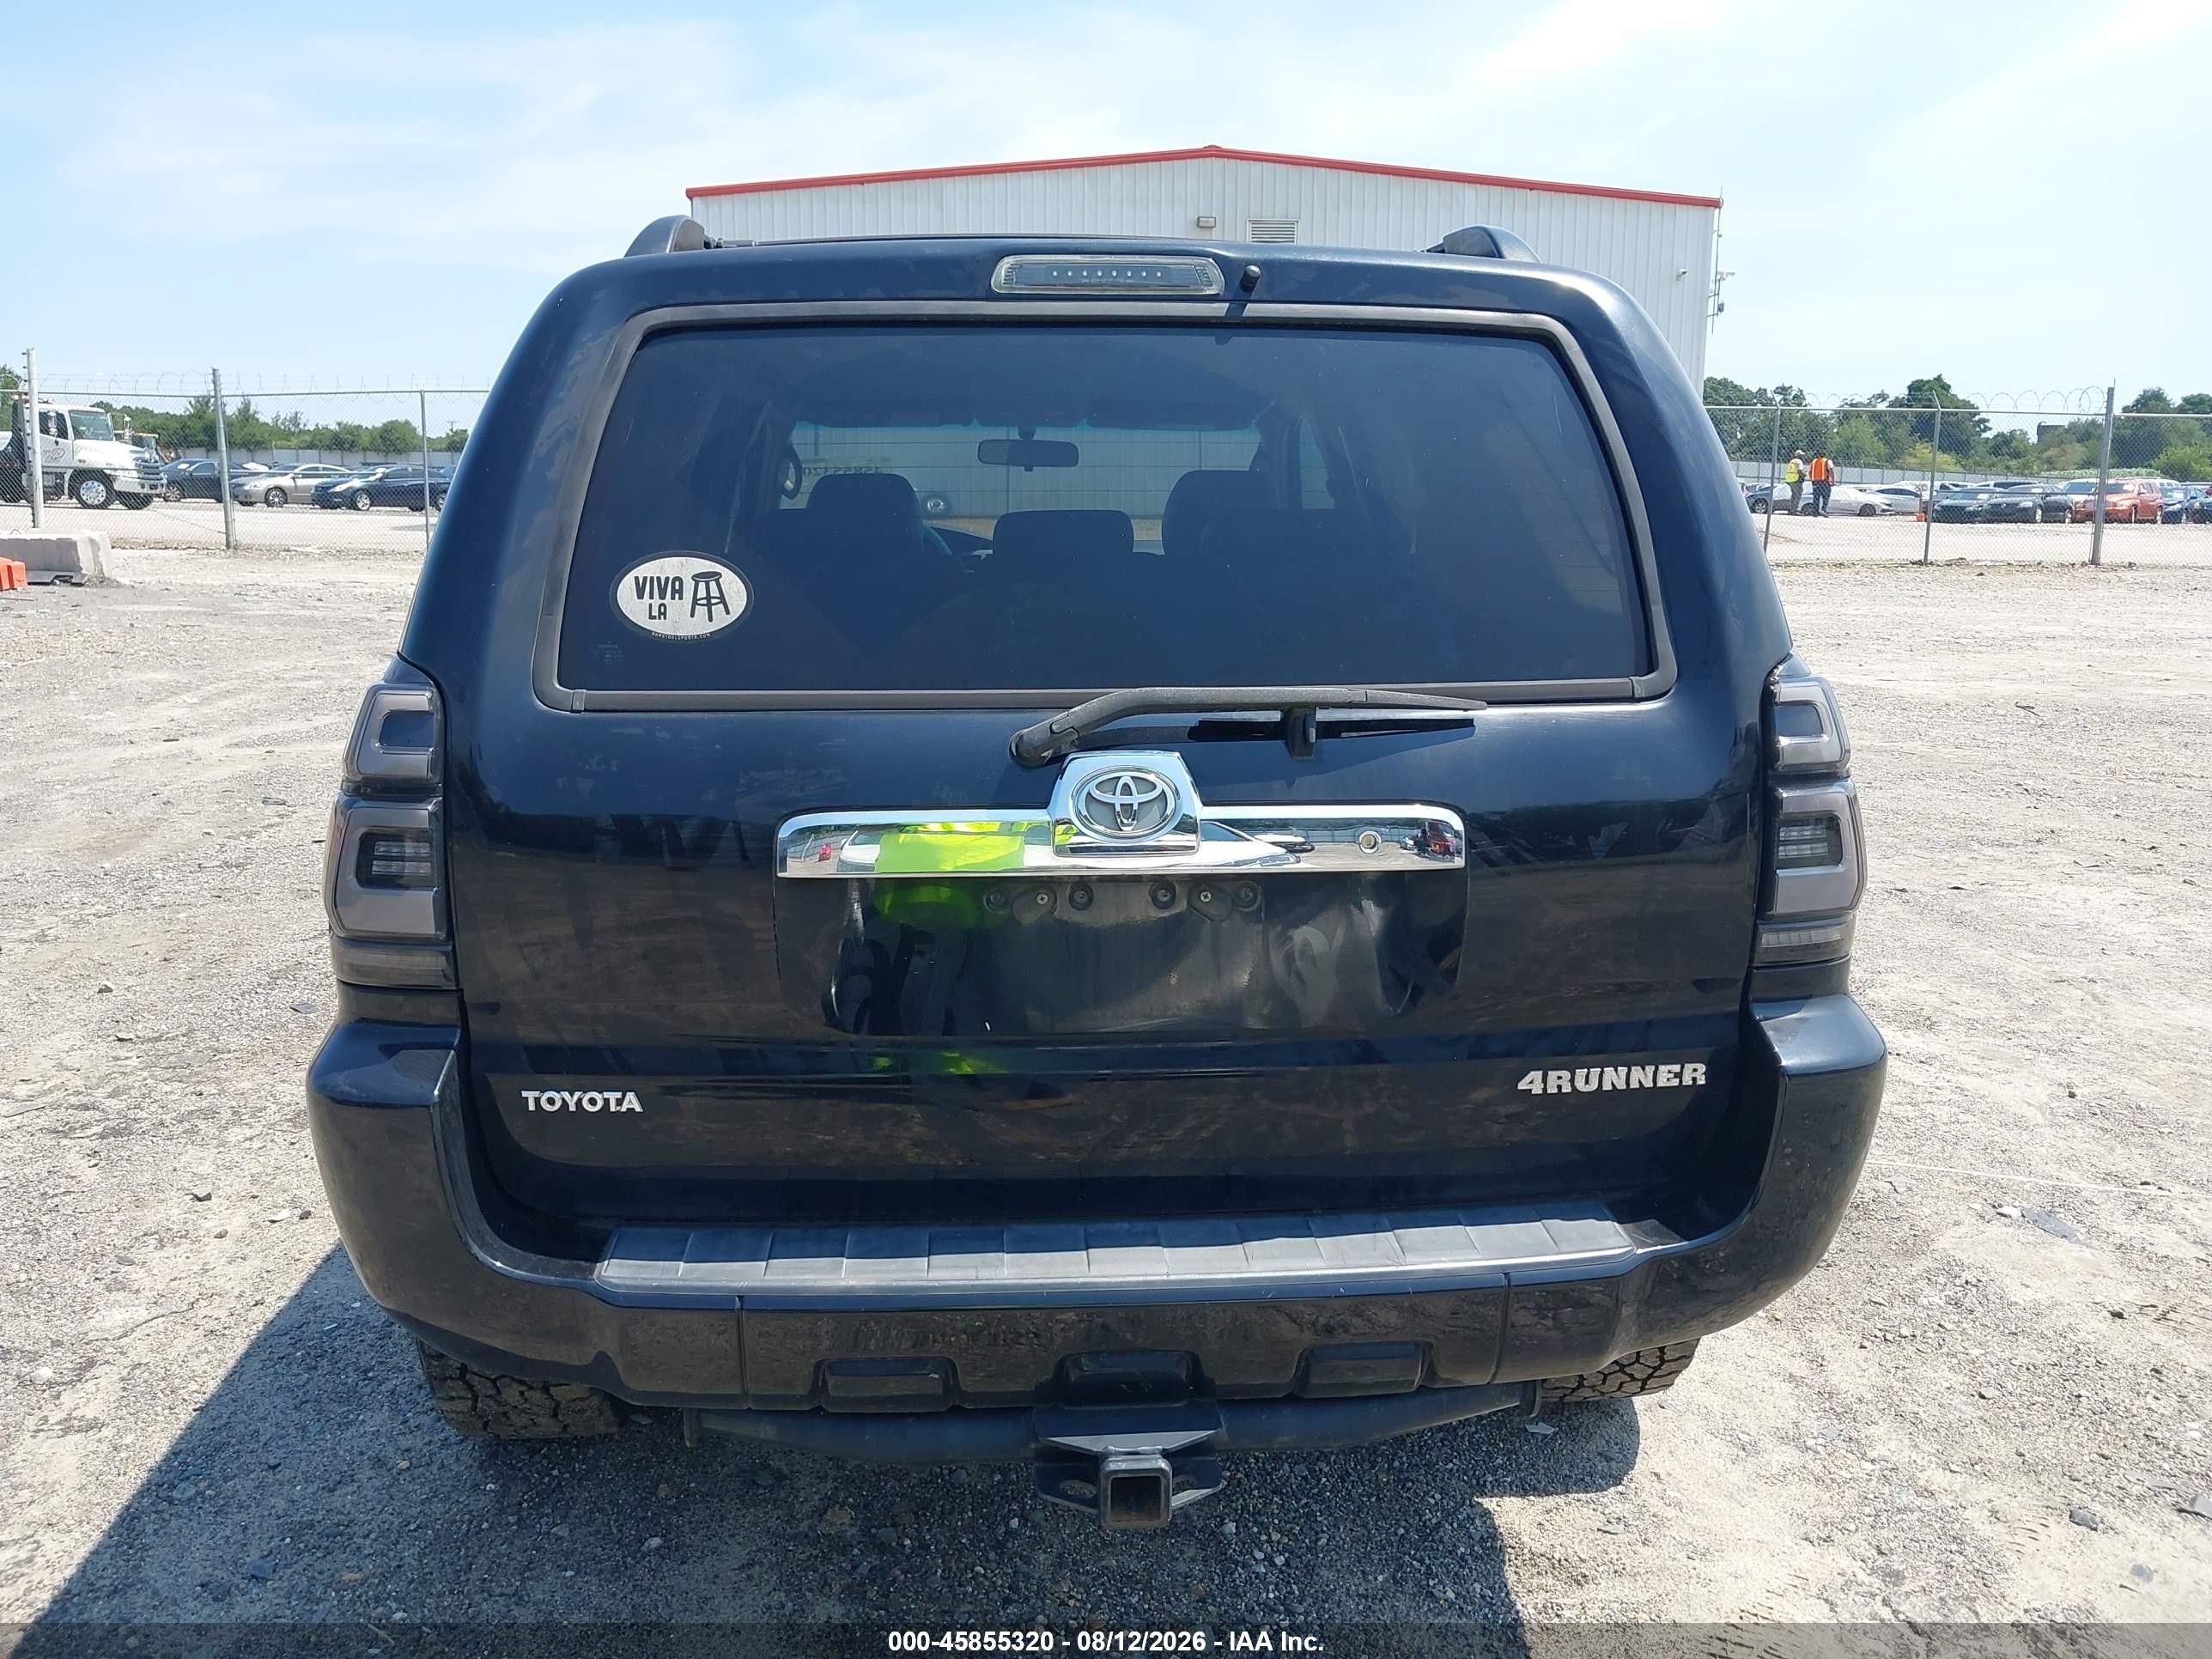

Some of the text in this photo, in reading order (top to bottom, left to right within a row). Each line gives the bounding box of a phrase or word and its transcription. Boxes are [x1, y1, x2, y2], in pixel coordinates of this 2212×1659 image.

[634, 575, 684, 601] VIVA
[648, 603, 667, 620] LA
[1517, 1063, 1706, 1095] 4RUNNER
[520, 1091, 644, 1112] TOYOTA
